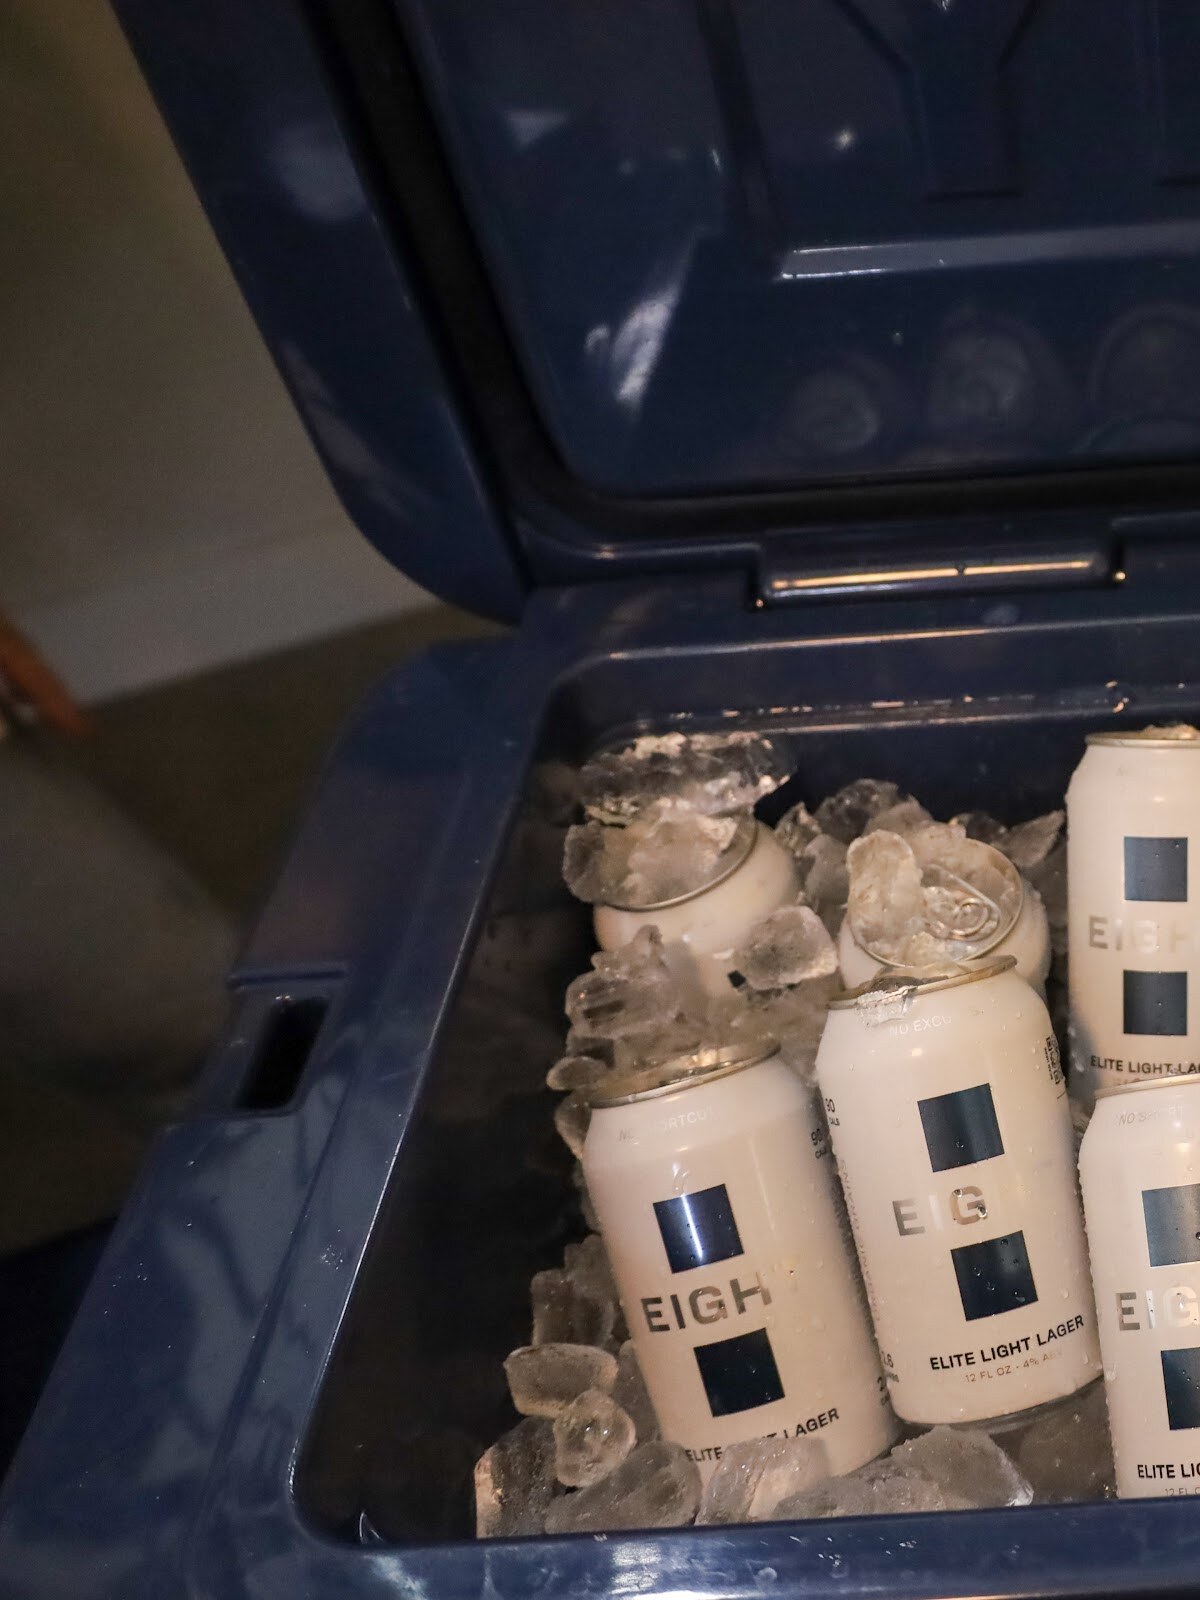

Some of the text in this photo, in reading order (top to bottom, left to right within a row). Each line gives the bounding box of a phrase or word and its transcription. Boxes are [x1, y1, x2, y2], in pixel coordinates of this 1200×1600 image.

[913, 1014, 953, 1033] EXCU
[1090, 1054, 1125, 1072] ELITE
[1128, 1060, 1173, 1075] LIGHT
[892, 1185, 988, 1237] EIG
[640, 1277, 774, 1333] EIGH
[929, 1314, 1085, 1371] ELITE LIGHT LAGER
[980, 1370, 993, 1380] FL
[996, 1365, 1012, 1377] OZ
[1023, 1357, 1040, 1369] 4%
[1137, 1462, 1176, 1481] ELITE
